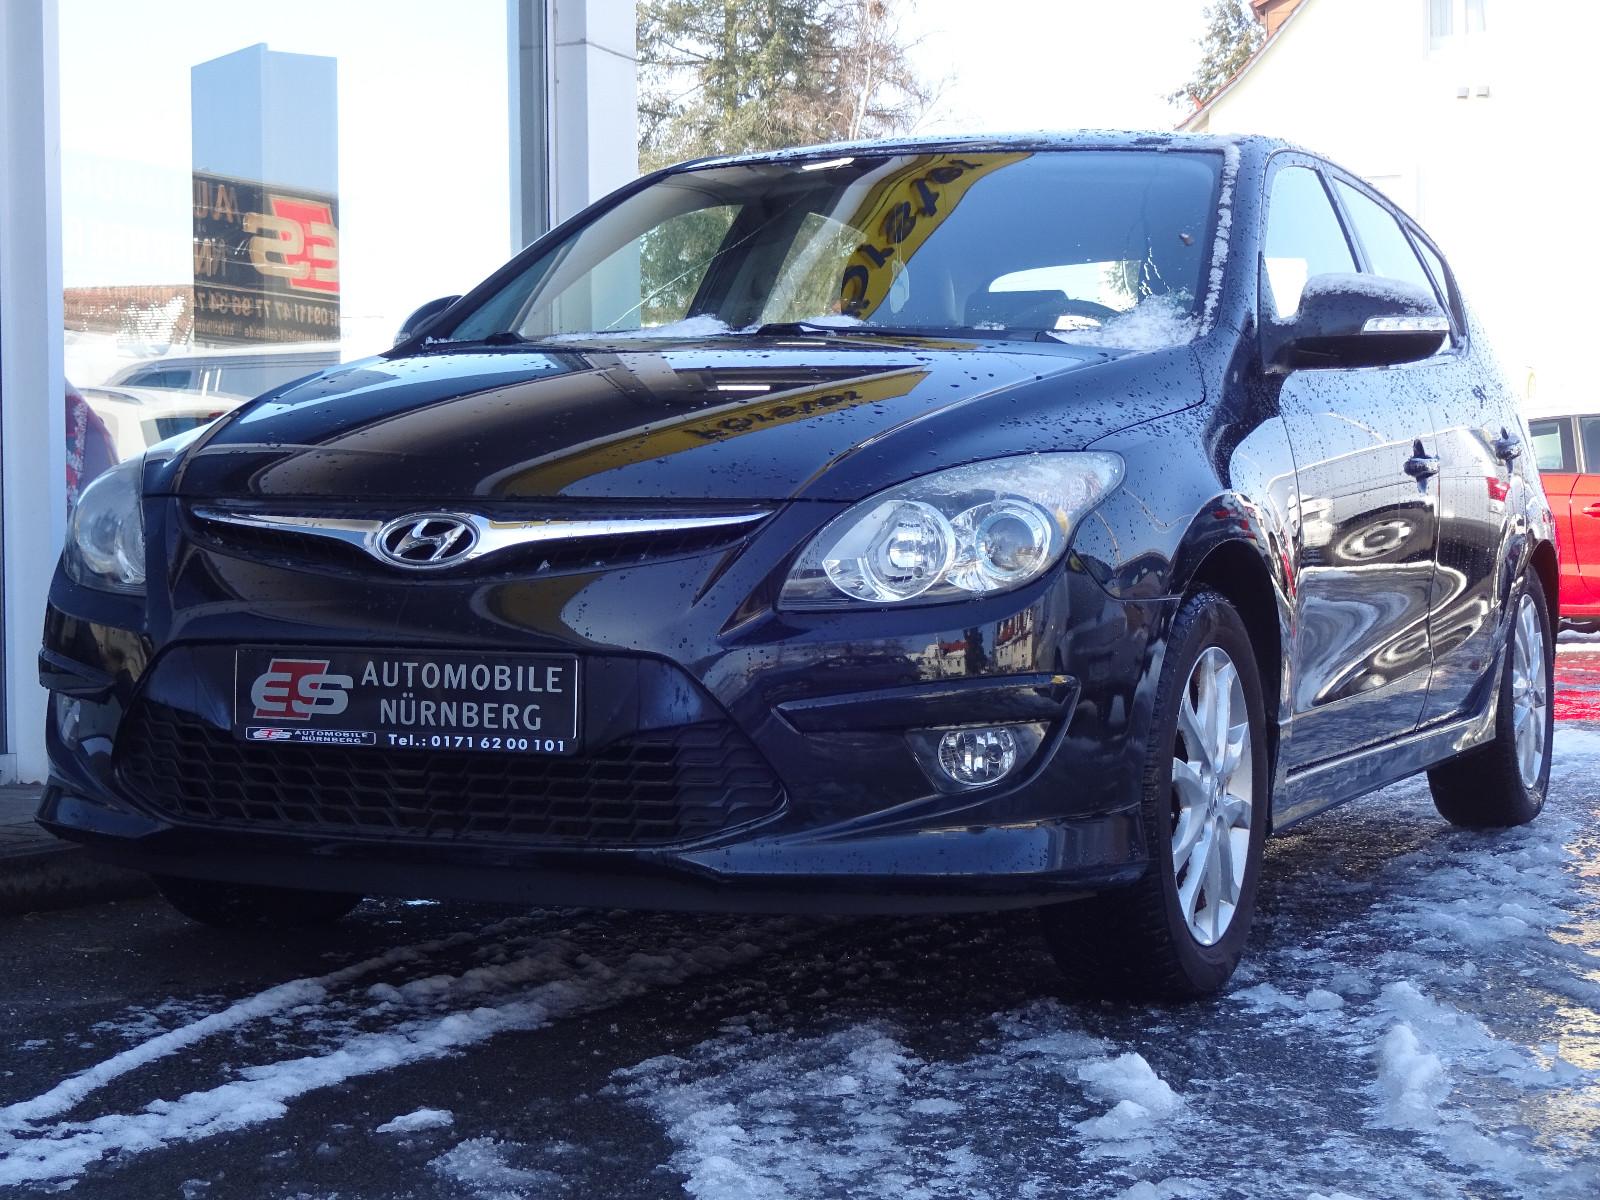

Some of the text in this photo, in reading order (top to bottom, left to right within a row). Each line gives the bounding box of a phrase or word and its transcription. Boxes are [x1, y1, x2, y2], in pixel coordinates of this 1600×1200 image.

[361, 661, 563, 693] AUTOMOBILE
[380, 692, 542, 731] NÜRNBERG
[294, 730, 368, 738] AUTOMOBILE
[301, 735, 361, 744] NÜRNBERG
[388, 733, 564, 752] Tel.: 0171 62 00 101
